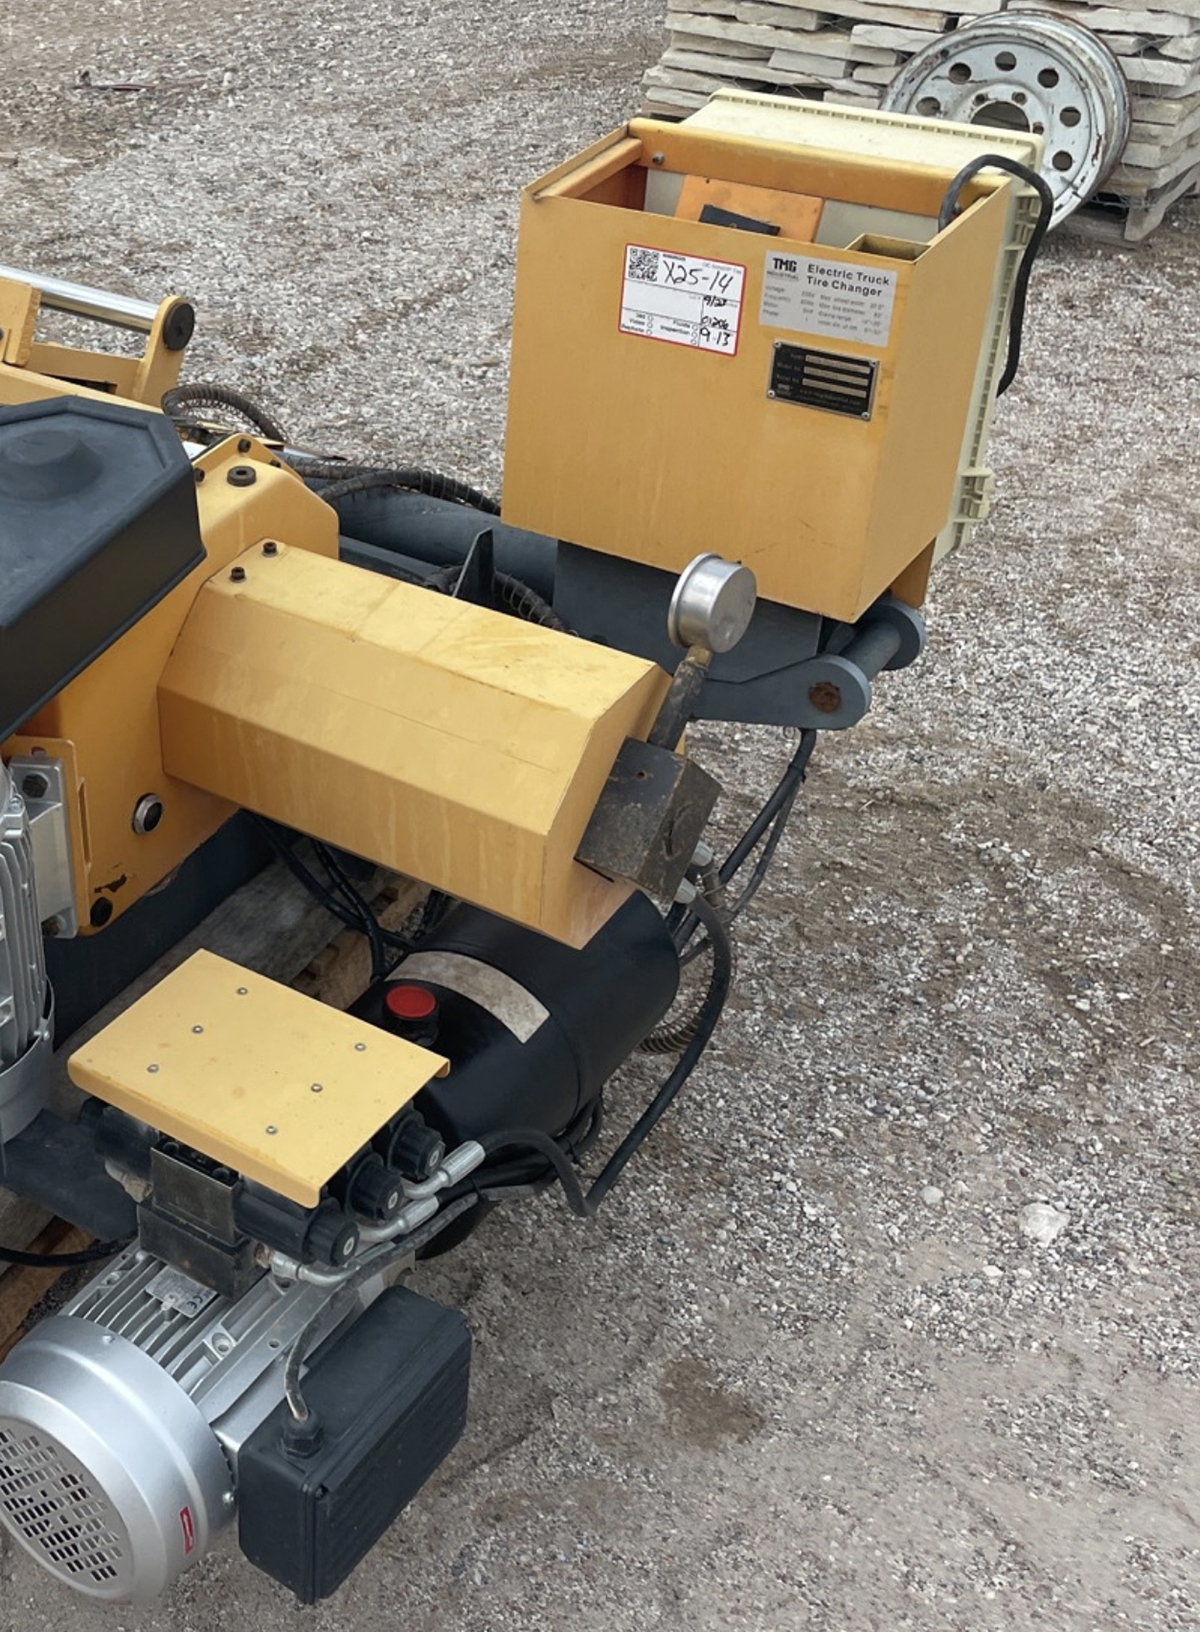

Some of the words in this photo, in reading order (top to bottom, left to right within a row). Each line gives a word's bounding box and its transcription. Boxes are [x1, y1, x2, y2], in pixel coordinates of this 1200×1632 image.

[772, 257, 798, 273] TMG
[807, 263, 853, 280] Electric
[856, 272, 890, 286] Truck
[663, 260, 734, 294] X25-14
[806, 275, 829, 288] Tire
[831, 280, 883, 297] Changer
